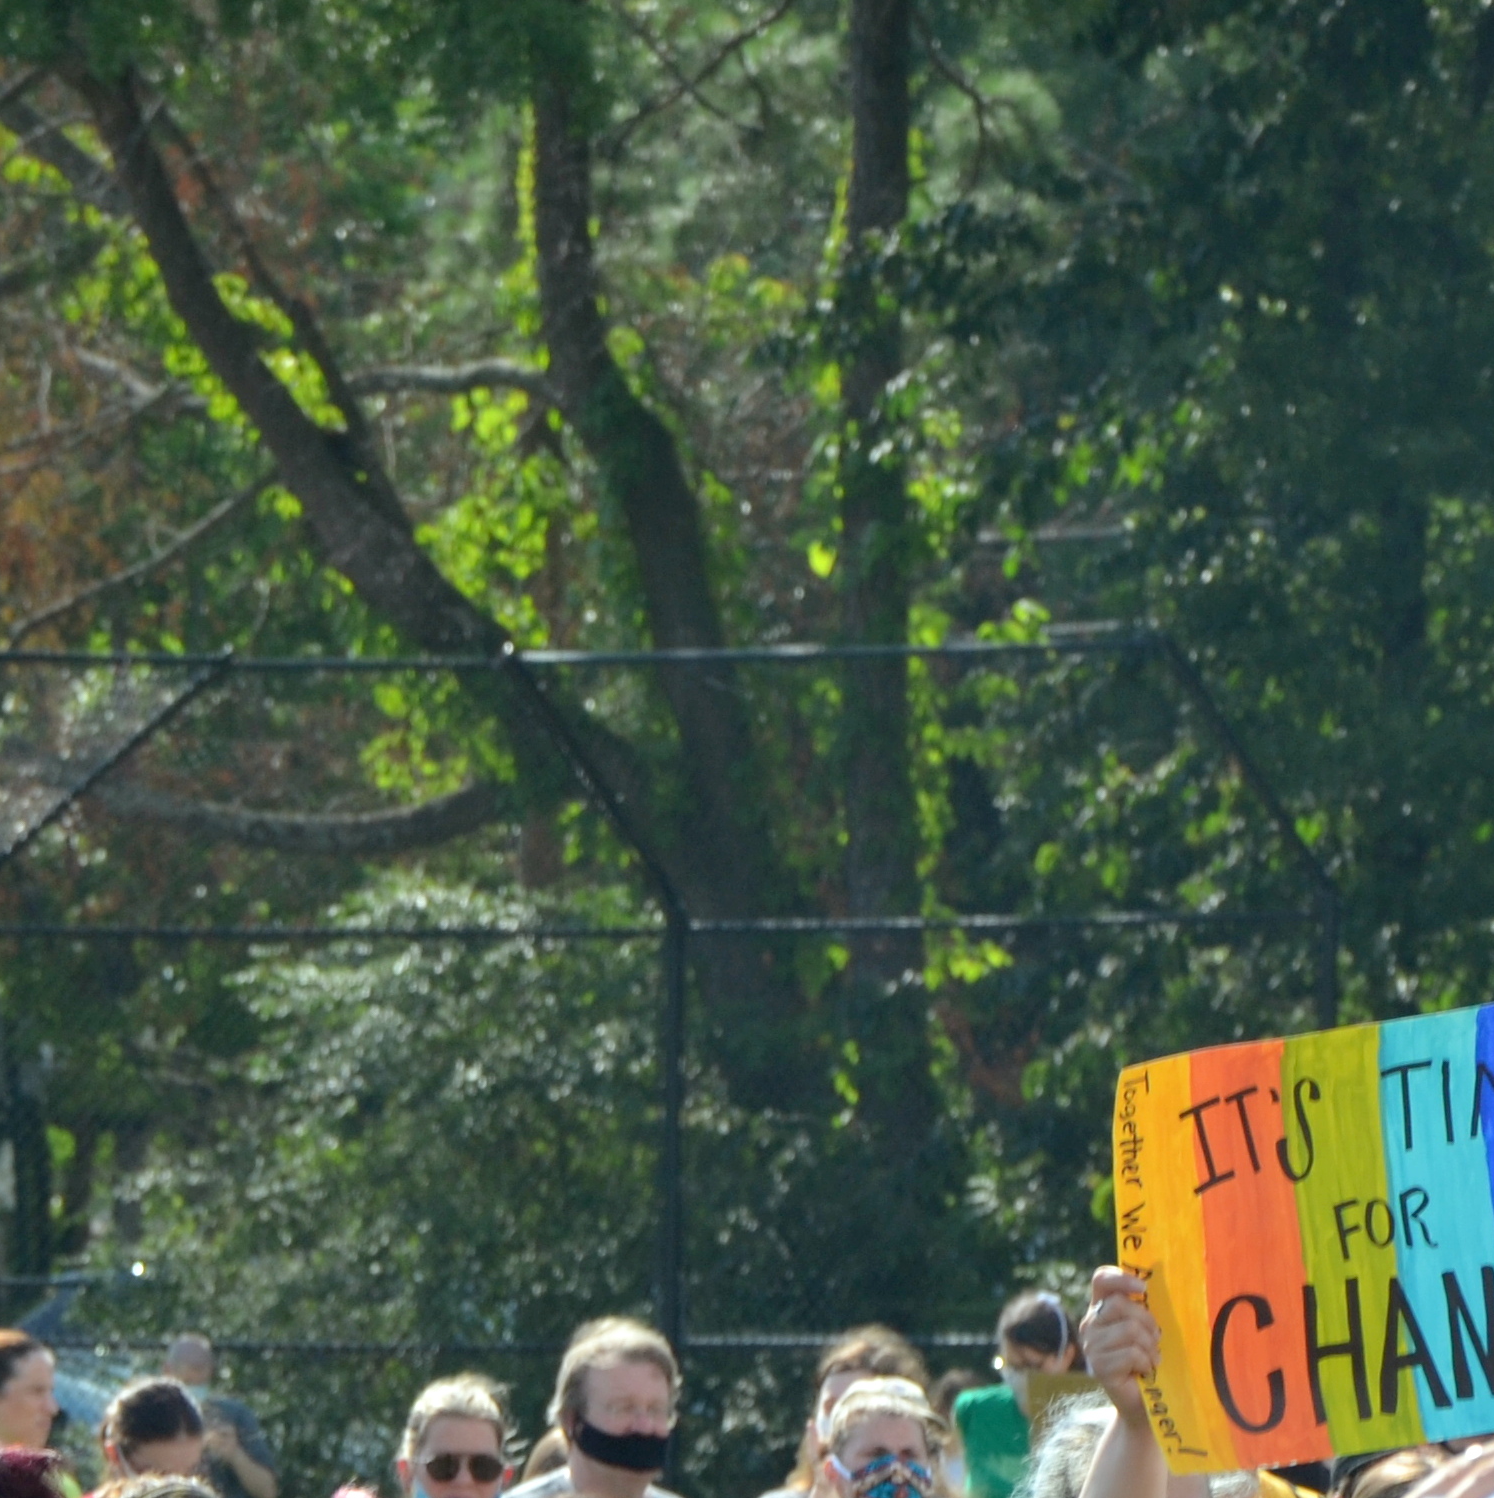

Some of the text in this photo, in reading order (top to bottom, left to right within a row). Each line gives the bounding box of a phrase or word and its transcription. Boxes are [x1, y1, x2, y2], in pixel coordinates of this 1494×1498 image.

[1120, 1071, 1149, 1194] Together
[1178, 1077, 1321, 1196] IT'S
[1122, 1201, 1147, 1252] We
[1333, 1186, 1438, 1261] FOR
